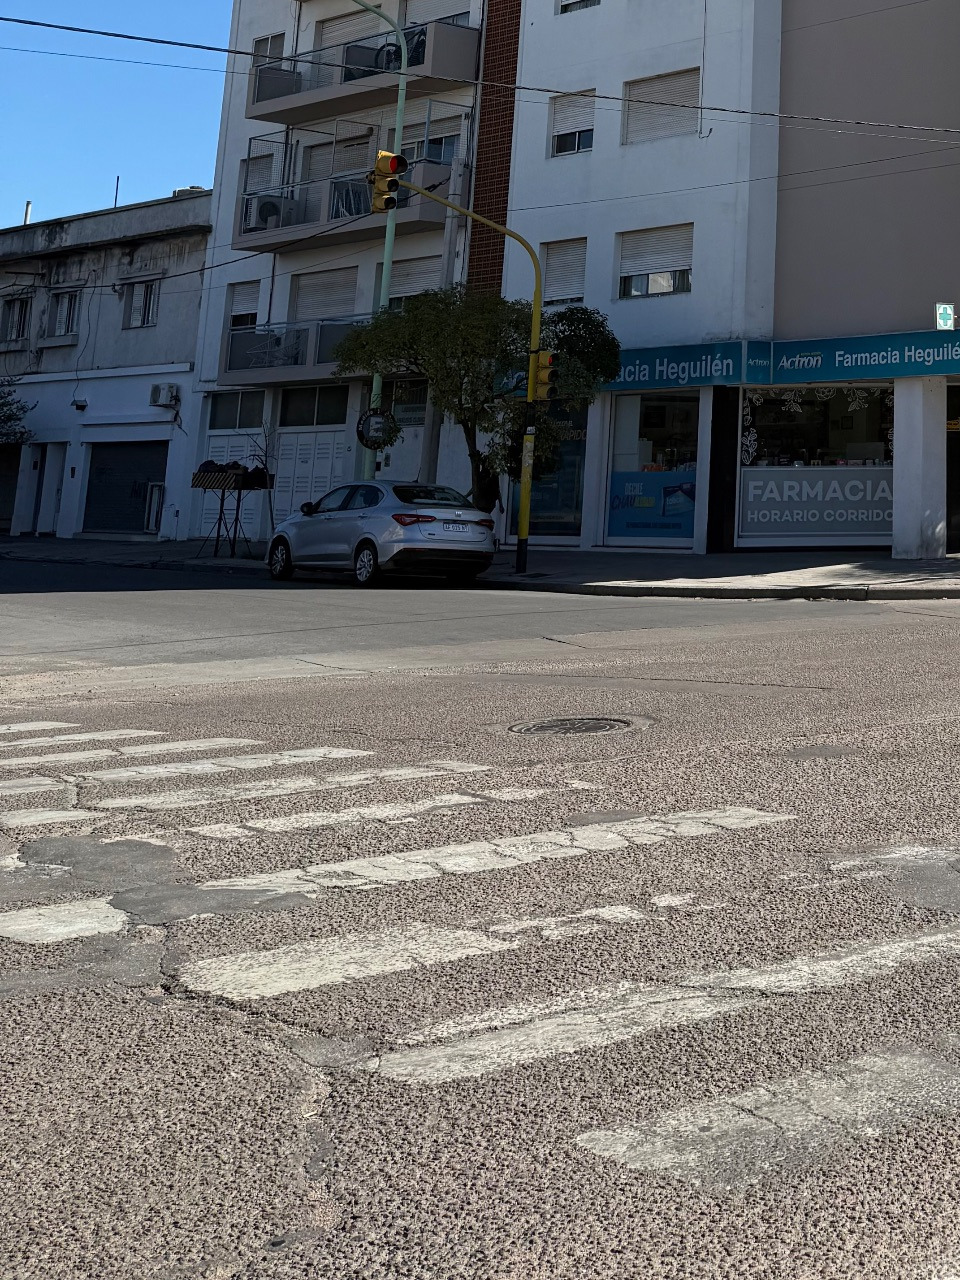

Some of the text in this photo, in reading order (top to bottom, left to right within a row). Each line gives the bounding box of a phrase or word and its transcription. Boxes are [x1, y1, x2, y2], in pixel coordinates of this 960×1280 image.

[747, 358, 770, 368] Actron
[777, 354, 823, 371] Actron
[835, 347, 900, 368] Farmacia
[612, 353, 734, 384] acia Heguilén
[748, 480, 893, 502] FARMACIA
[747, 509, 893, 523] HORARIO CORRIDO
